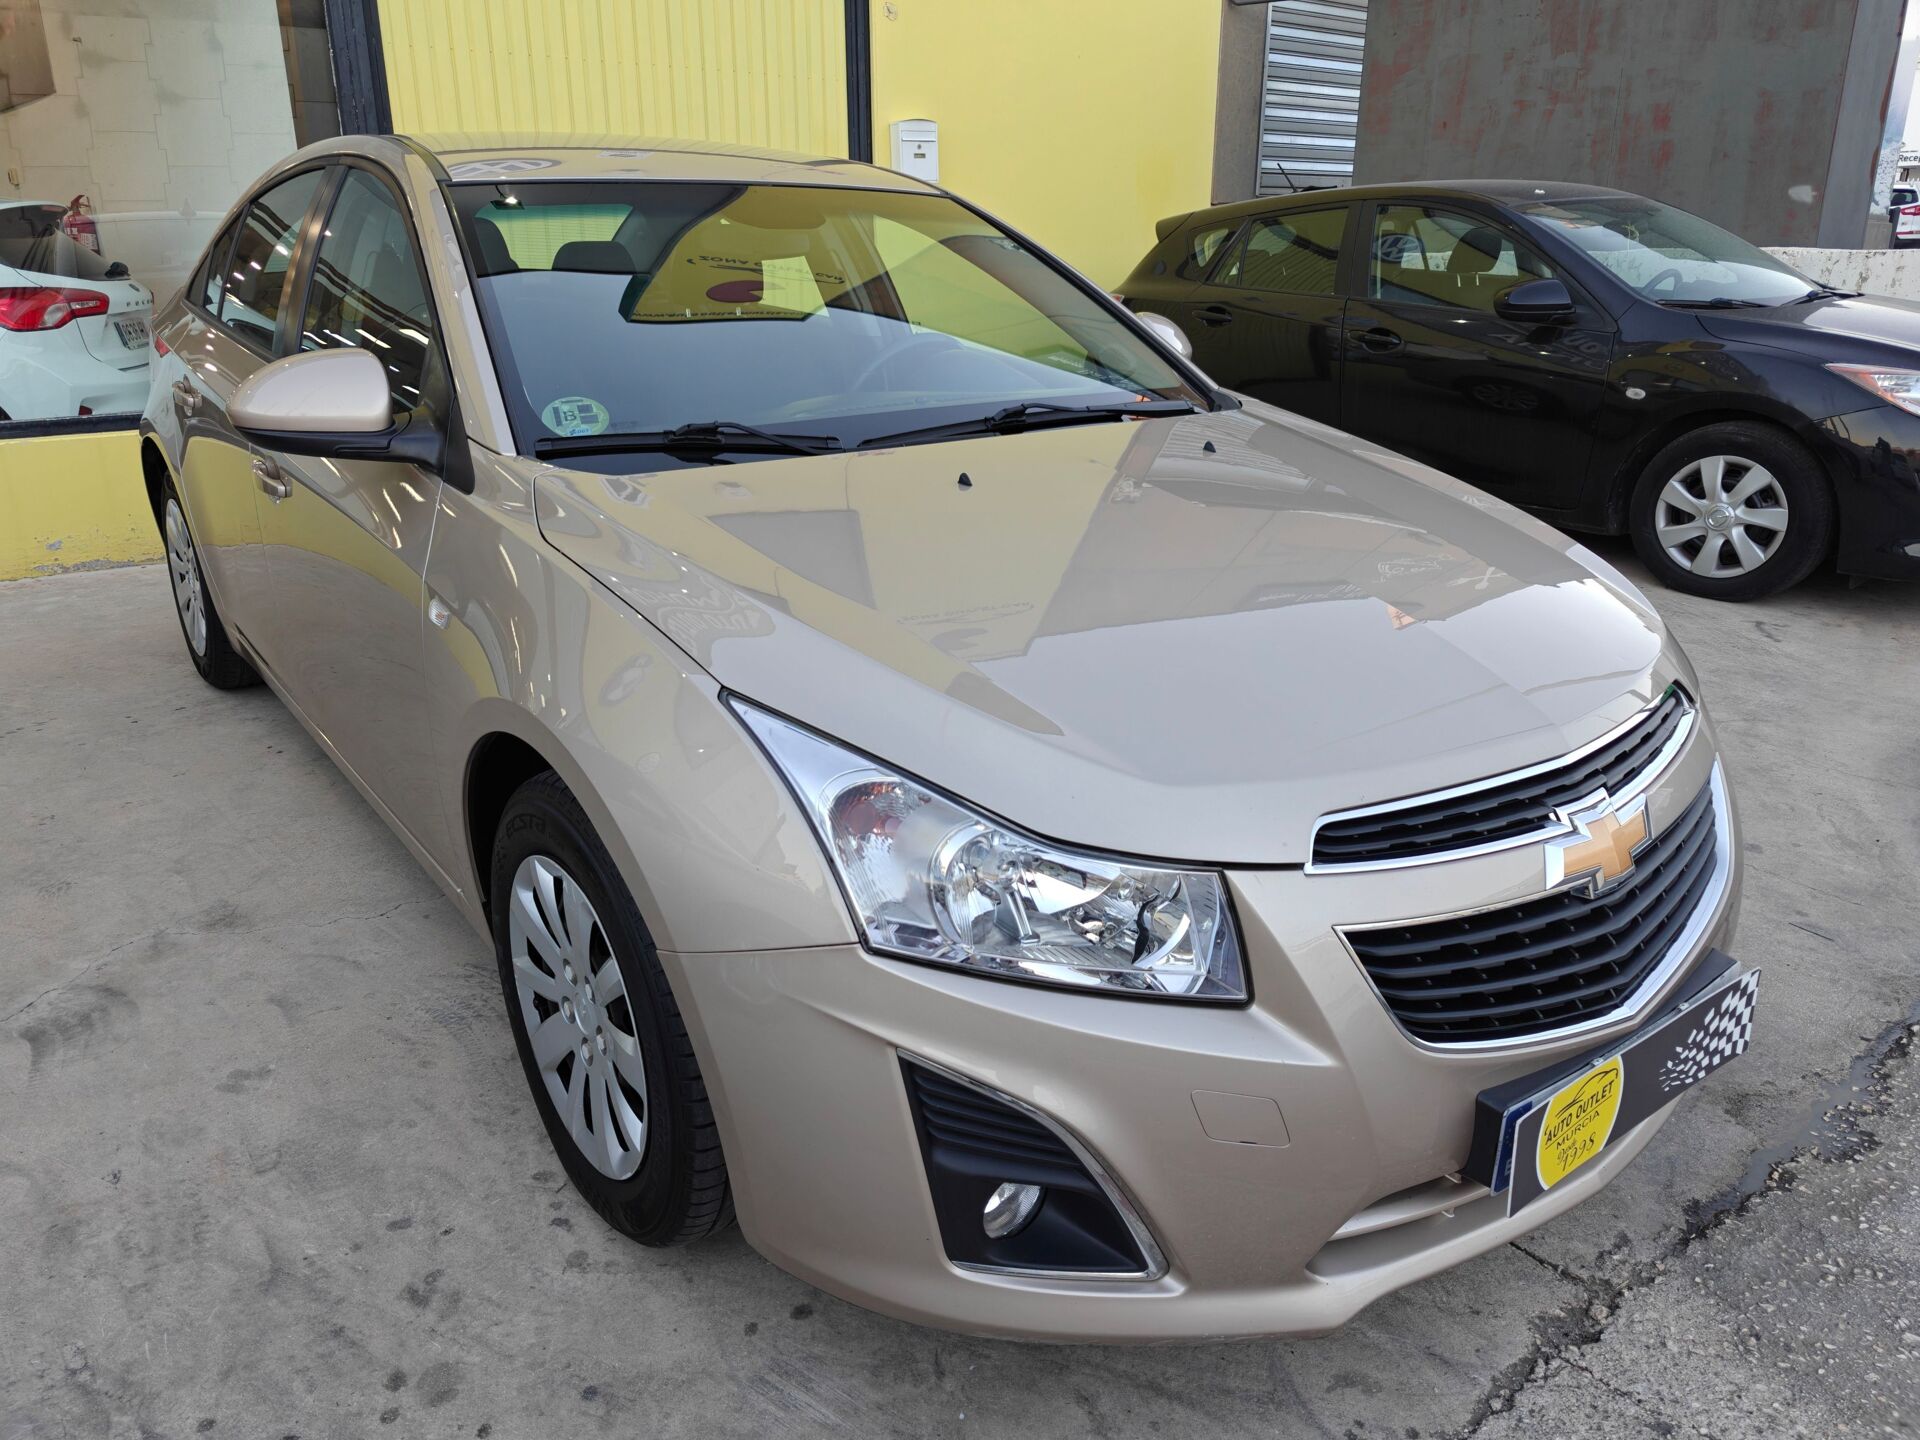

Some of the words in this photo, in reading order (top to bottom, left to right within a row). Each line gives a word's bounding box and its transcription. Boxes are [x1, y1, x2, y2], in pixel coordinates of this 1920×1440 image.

[1546, 1113, 1572, 1144] AUTO
[1576, 1080, 1614, 1118] OUTLET
[1556, 1110, 1600, 1150] MURCIA
[1562, 1131, 1597, 1172] 1998
